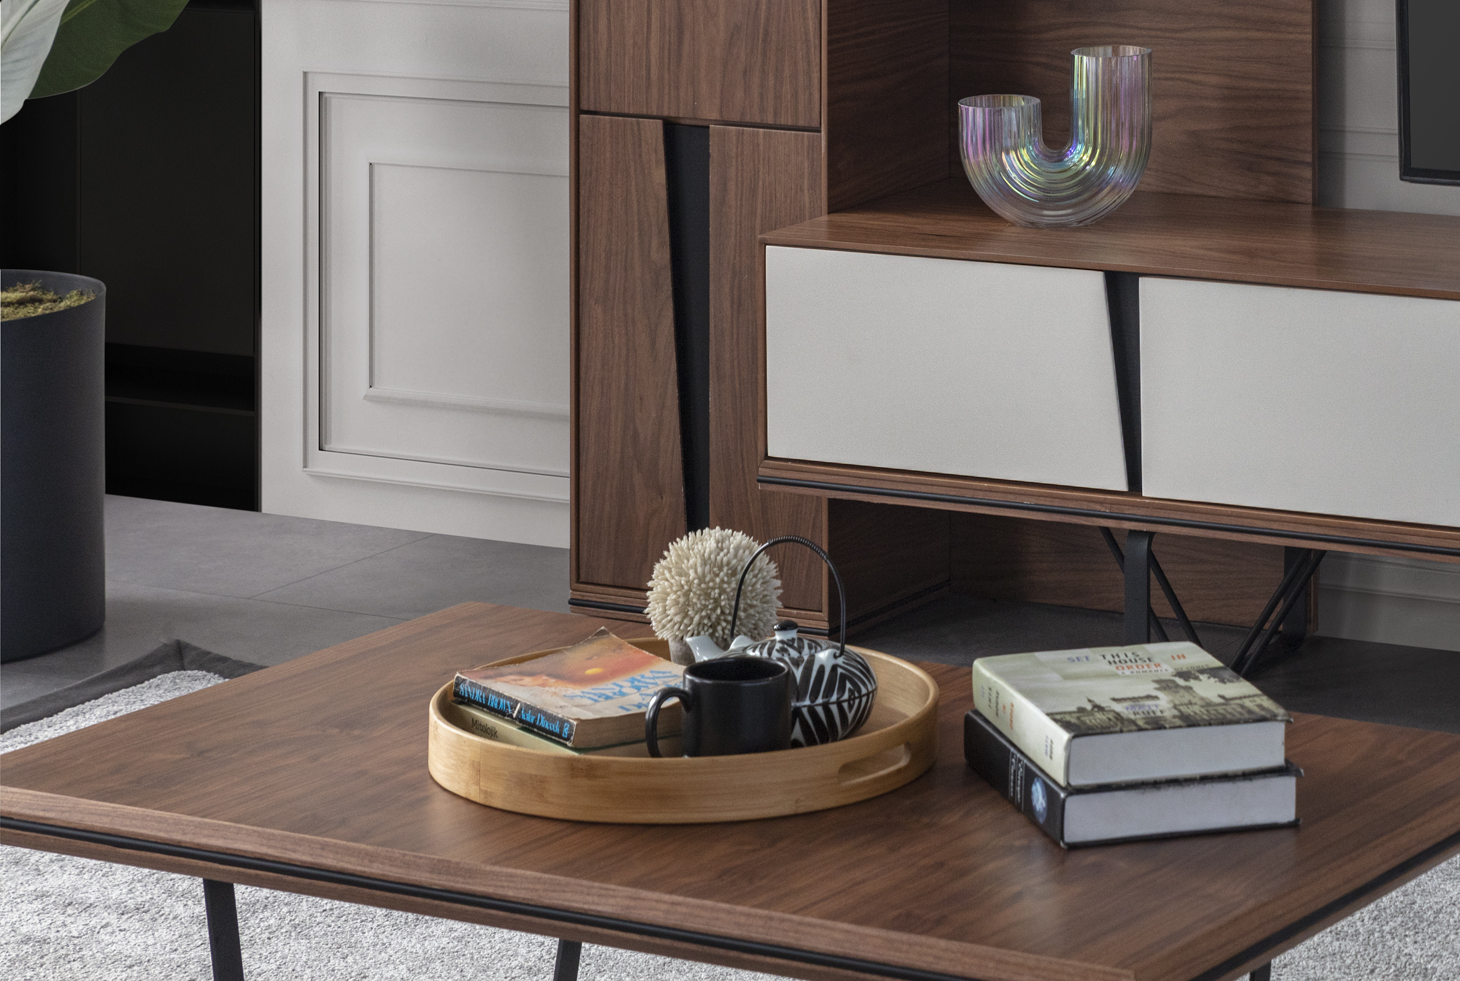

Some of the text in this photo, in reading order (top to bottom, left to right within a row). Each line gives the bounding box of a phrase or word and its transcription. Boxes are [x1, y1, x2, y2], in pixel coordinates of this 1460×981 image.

[1100, 651, 1140, 660] THIS
[1107, 657, 1154, 665] HOUSE
[1115, 663, 1162, 671] ORDER
[459, 683, 486, 704] SANDRA
[488, 693, 512, 713] BROWN
